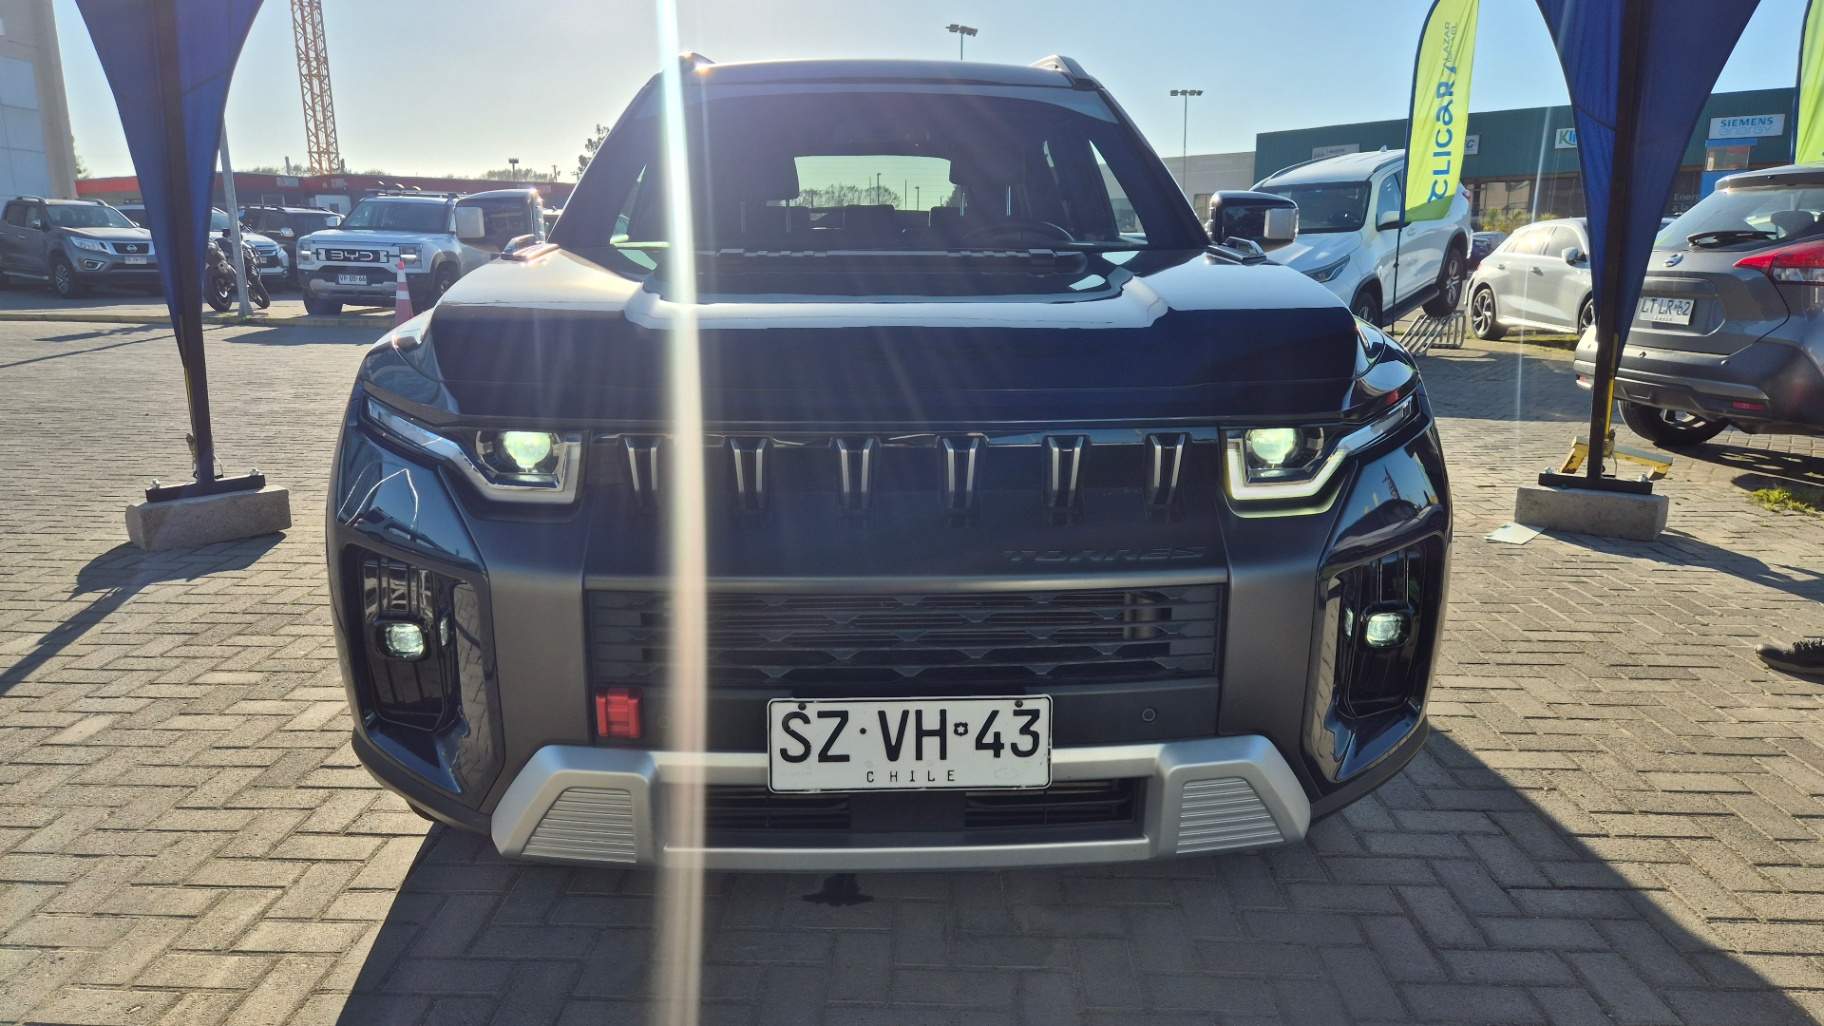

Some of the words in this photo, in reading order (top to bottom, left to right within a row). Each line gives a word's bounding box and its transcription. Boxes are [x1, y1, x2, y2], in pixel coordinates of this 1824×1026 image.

[1720, 117, 1774, 127] SIEMENS
[331, 251, 373, 261] BYD
[866, 769, 956, 783] CHILE
